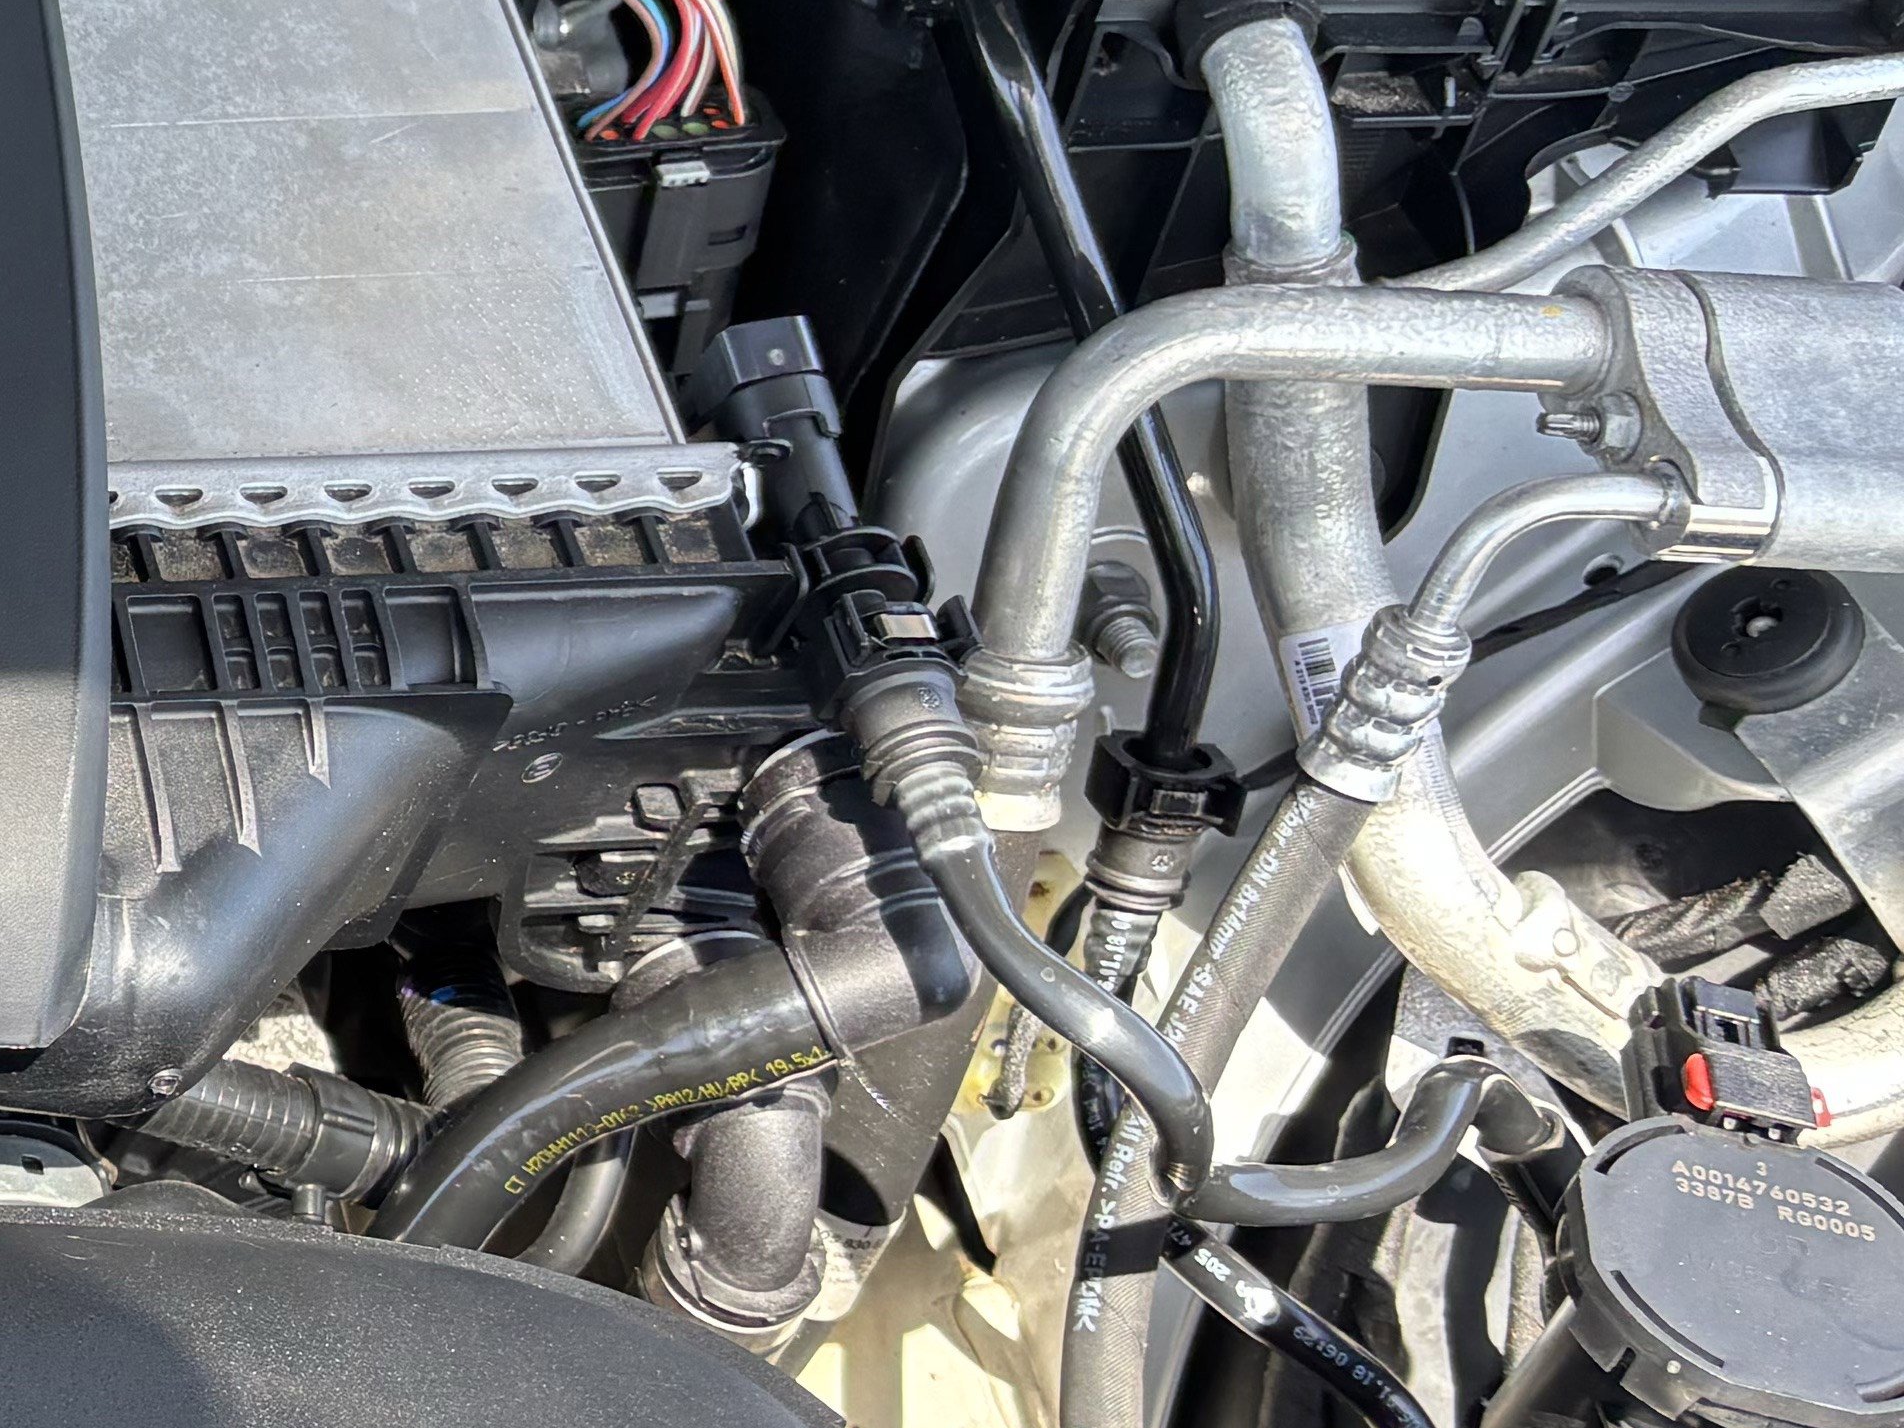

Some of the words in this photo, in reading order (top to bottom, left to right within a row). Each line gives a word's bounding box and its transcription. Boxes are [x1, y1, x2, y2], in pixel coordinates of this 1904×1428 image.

[1755, 1161, 1768, 1176] 3
[505, 1175, 527, 1196] CT
[1671, 1159, 1852, 1217] A0014760532
[1675, 1176, 1755, 1210] 3387B
[1777, 1205, 1877, 1242] RG0005
[1195, 1248, 1231, 1281] 205
